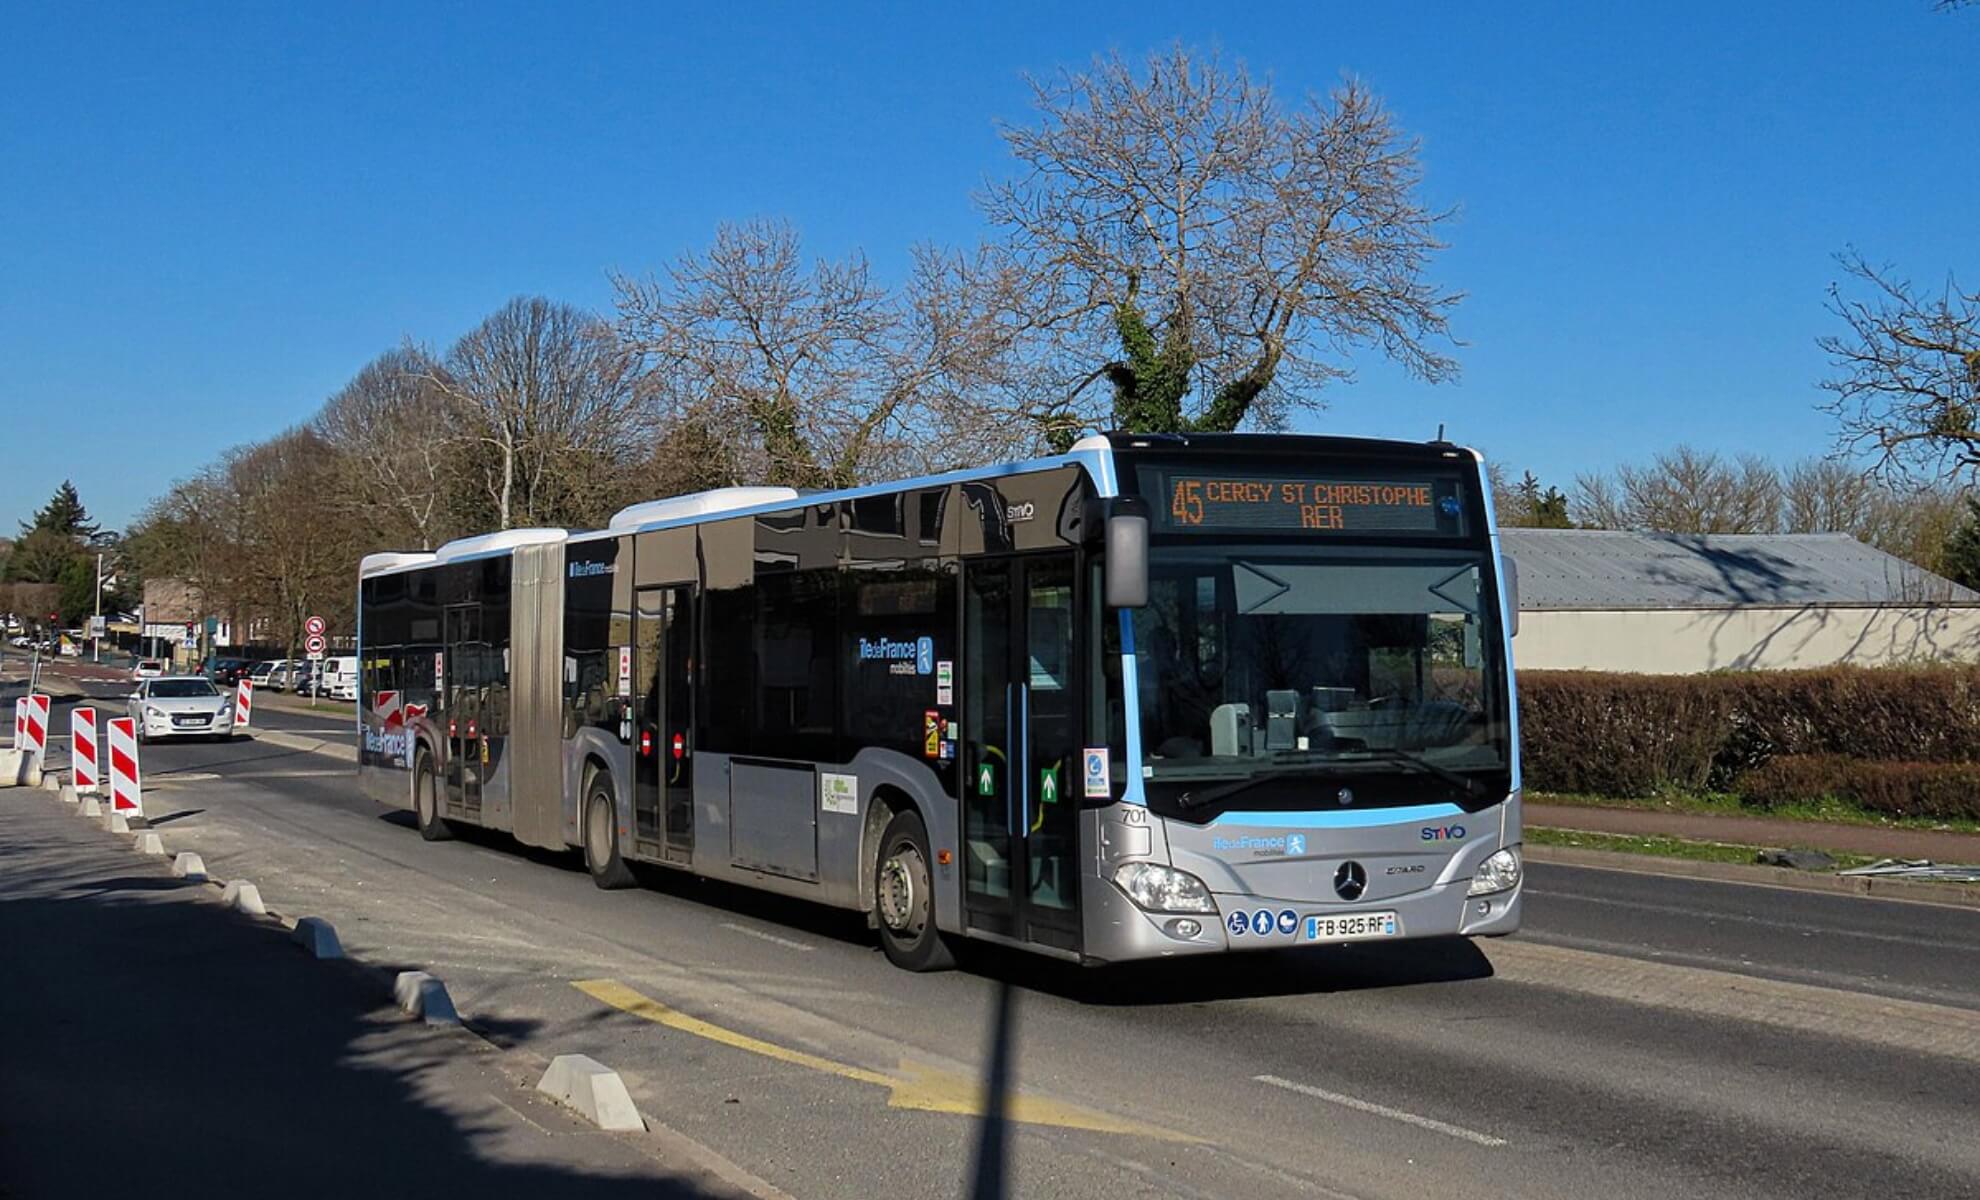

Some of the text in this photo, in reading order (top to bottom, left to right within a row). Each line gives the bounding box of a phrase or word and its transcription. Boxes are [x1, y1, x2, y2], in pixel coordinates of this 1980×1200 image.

[1172, 480, 1204, 523] 45
[1206, 482, 1431, 506] CERGY ST CHRISTOPHE
[1301, 505, 1344, 528] RER
[1121, 809, 1146, 823] 701
[1421, 824, 1466, 841] STIVO
